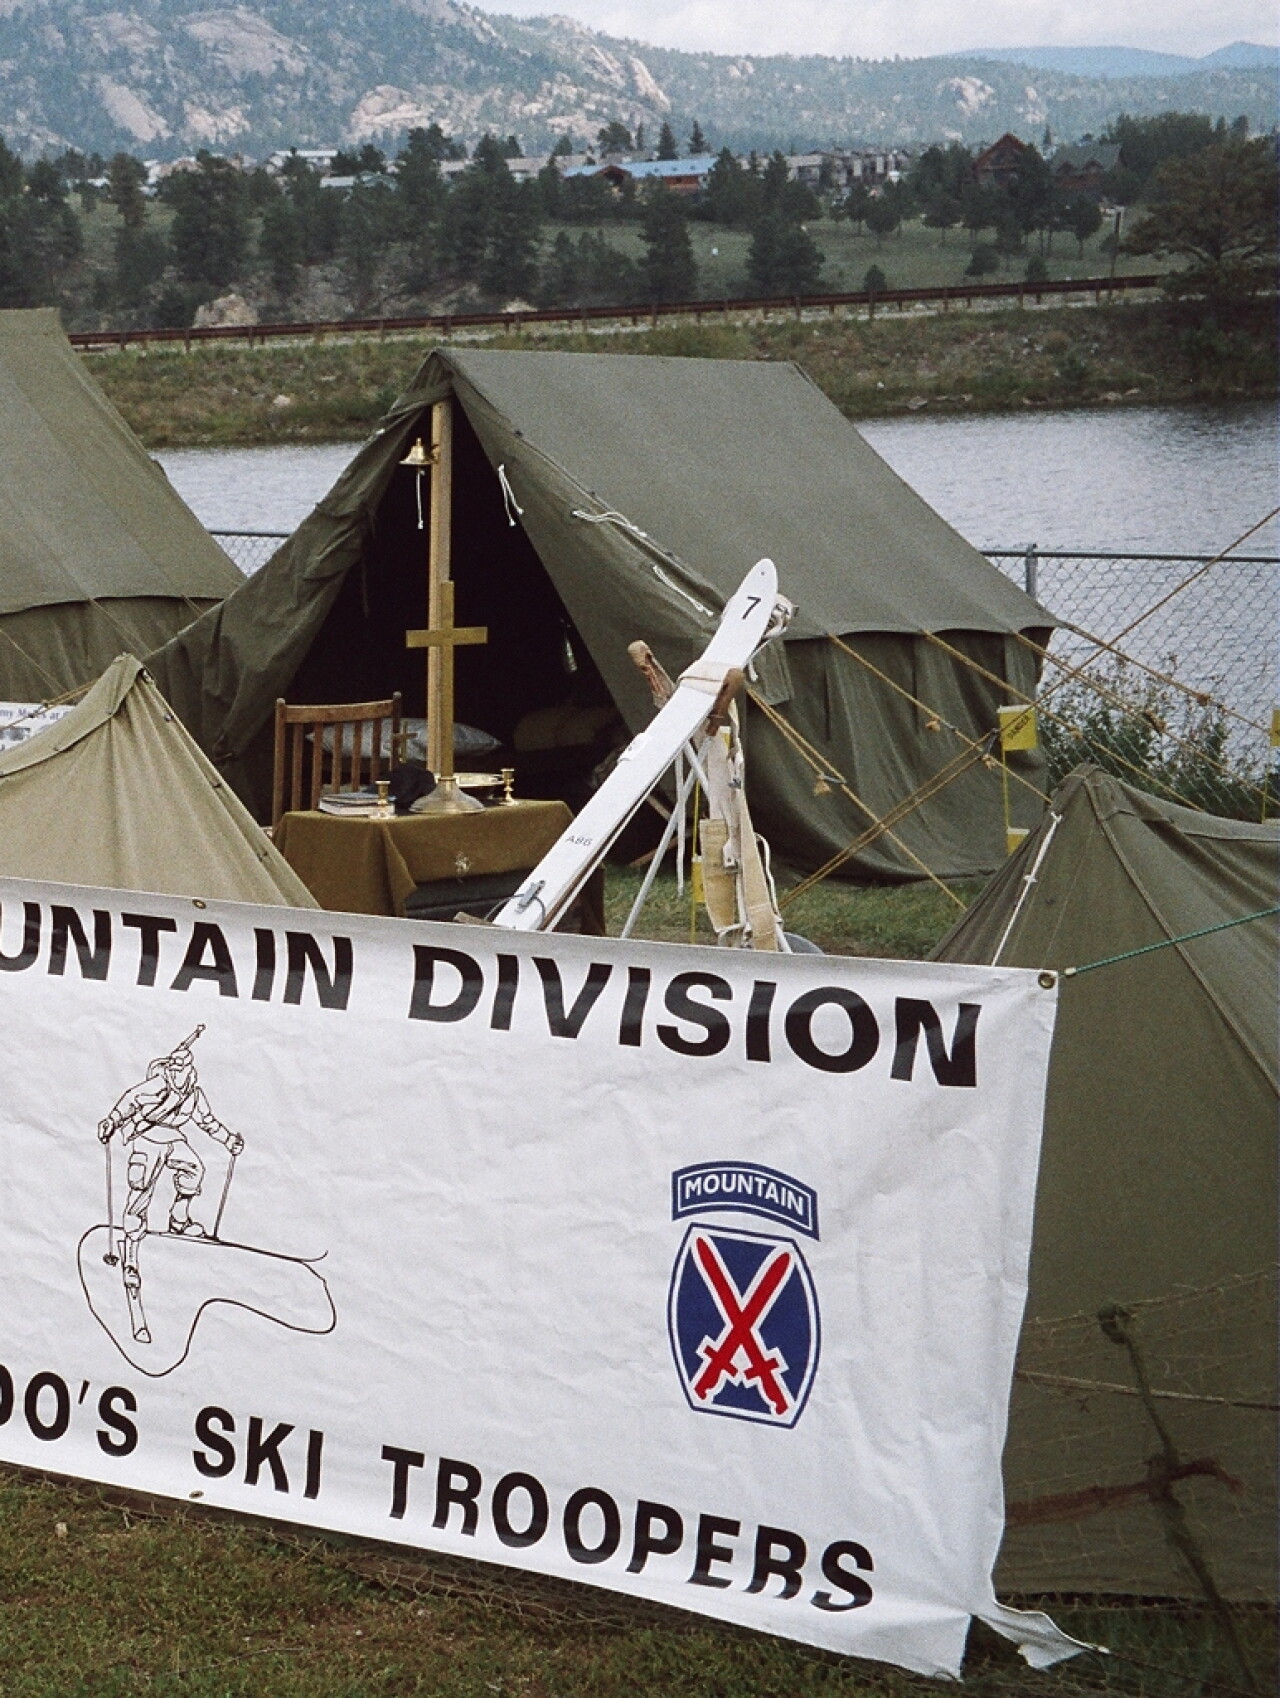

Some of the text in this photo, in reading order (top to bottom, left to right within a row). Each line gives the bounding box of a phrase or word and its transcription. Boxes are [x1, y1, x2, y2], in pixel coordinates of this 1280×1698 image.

[742, 595, 761, 620] 7
[408, 944, 983, 1087] DIVISION
[685, 1173, 804, 1216] MOUNTAIN
[193, 1405, 324, 1501] SKI
[381, 1444, 874, 1612] TROOPERS
